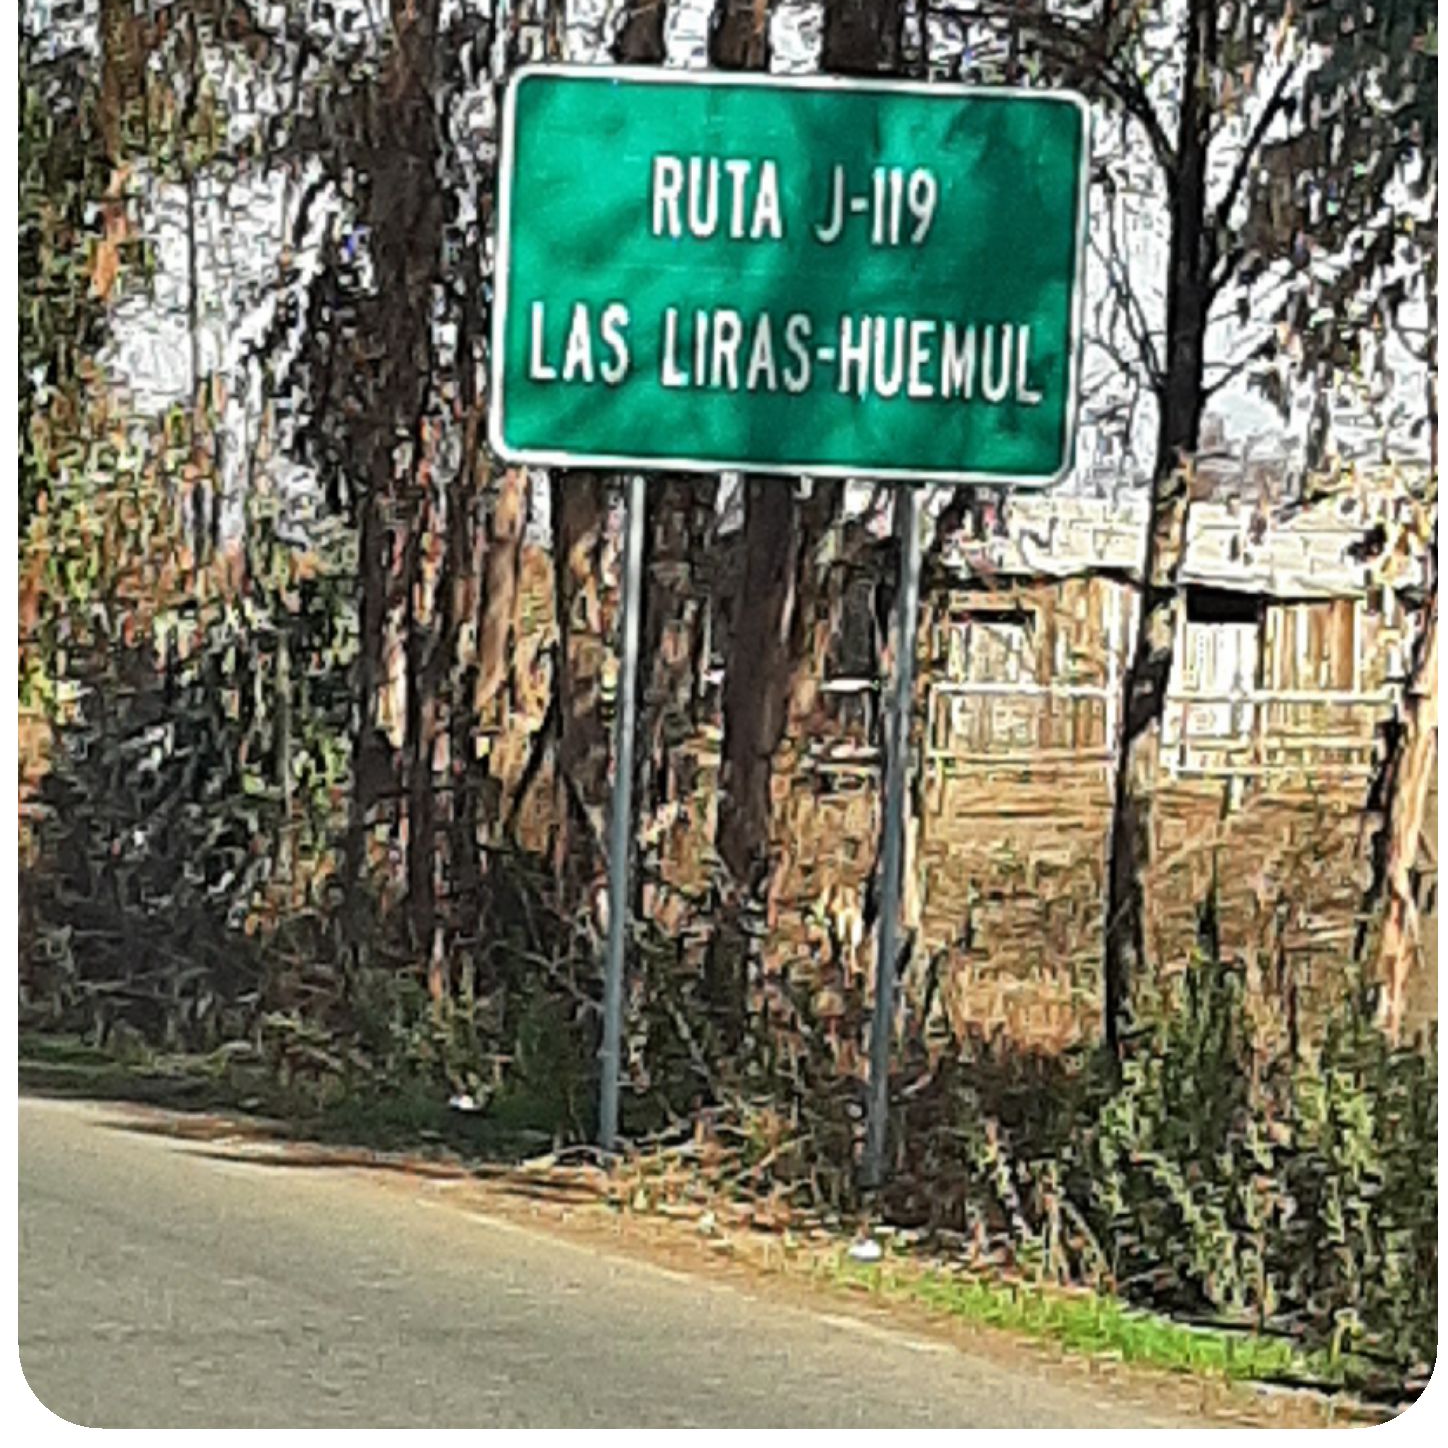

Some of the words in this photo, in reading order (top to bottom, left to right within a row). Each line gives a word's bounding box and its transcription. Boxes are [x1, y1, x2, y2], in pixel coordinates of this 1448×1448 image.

[652, 156, 782, 239] RUTA
[816, 165, 938, 245] J-119
[530, 302, 630, 384] LAS
[660, 308, 1044, 404] LIRAS-HUEMUL
